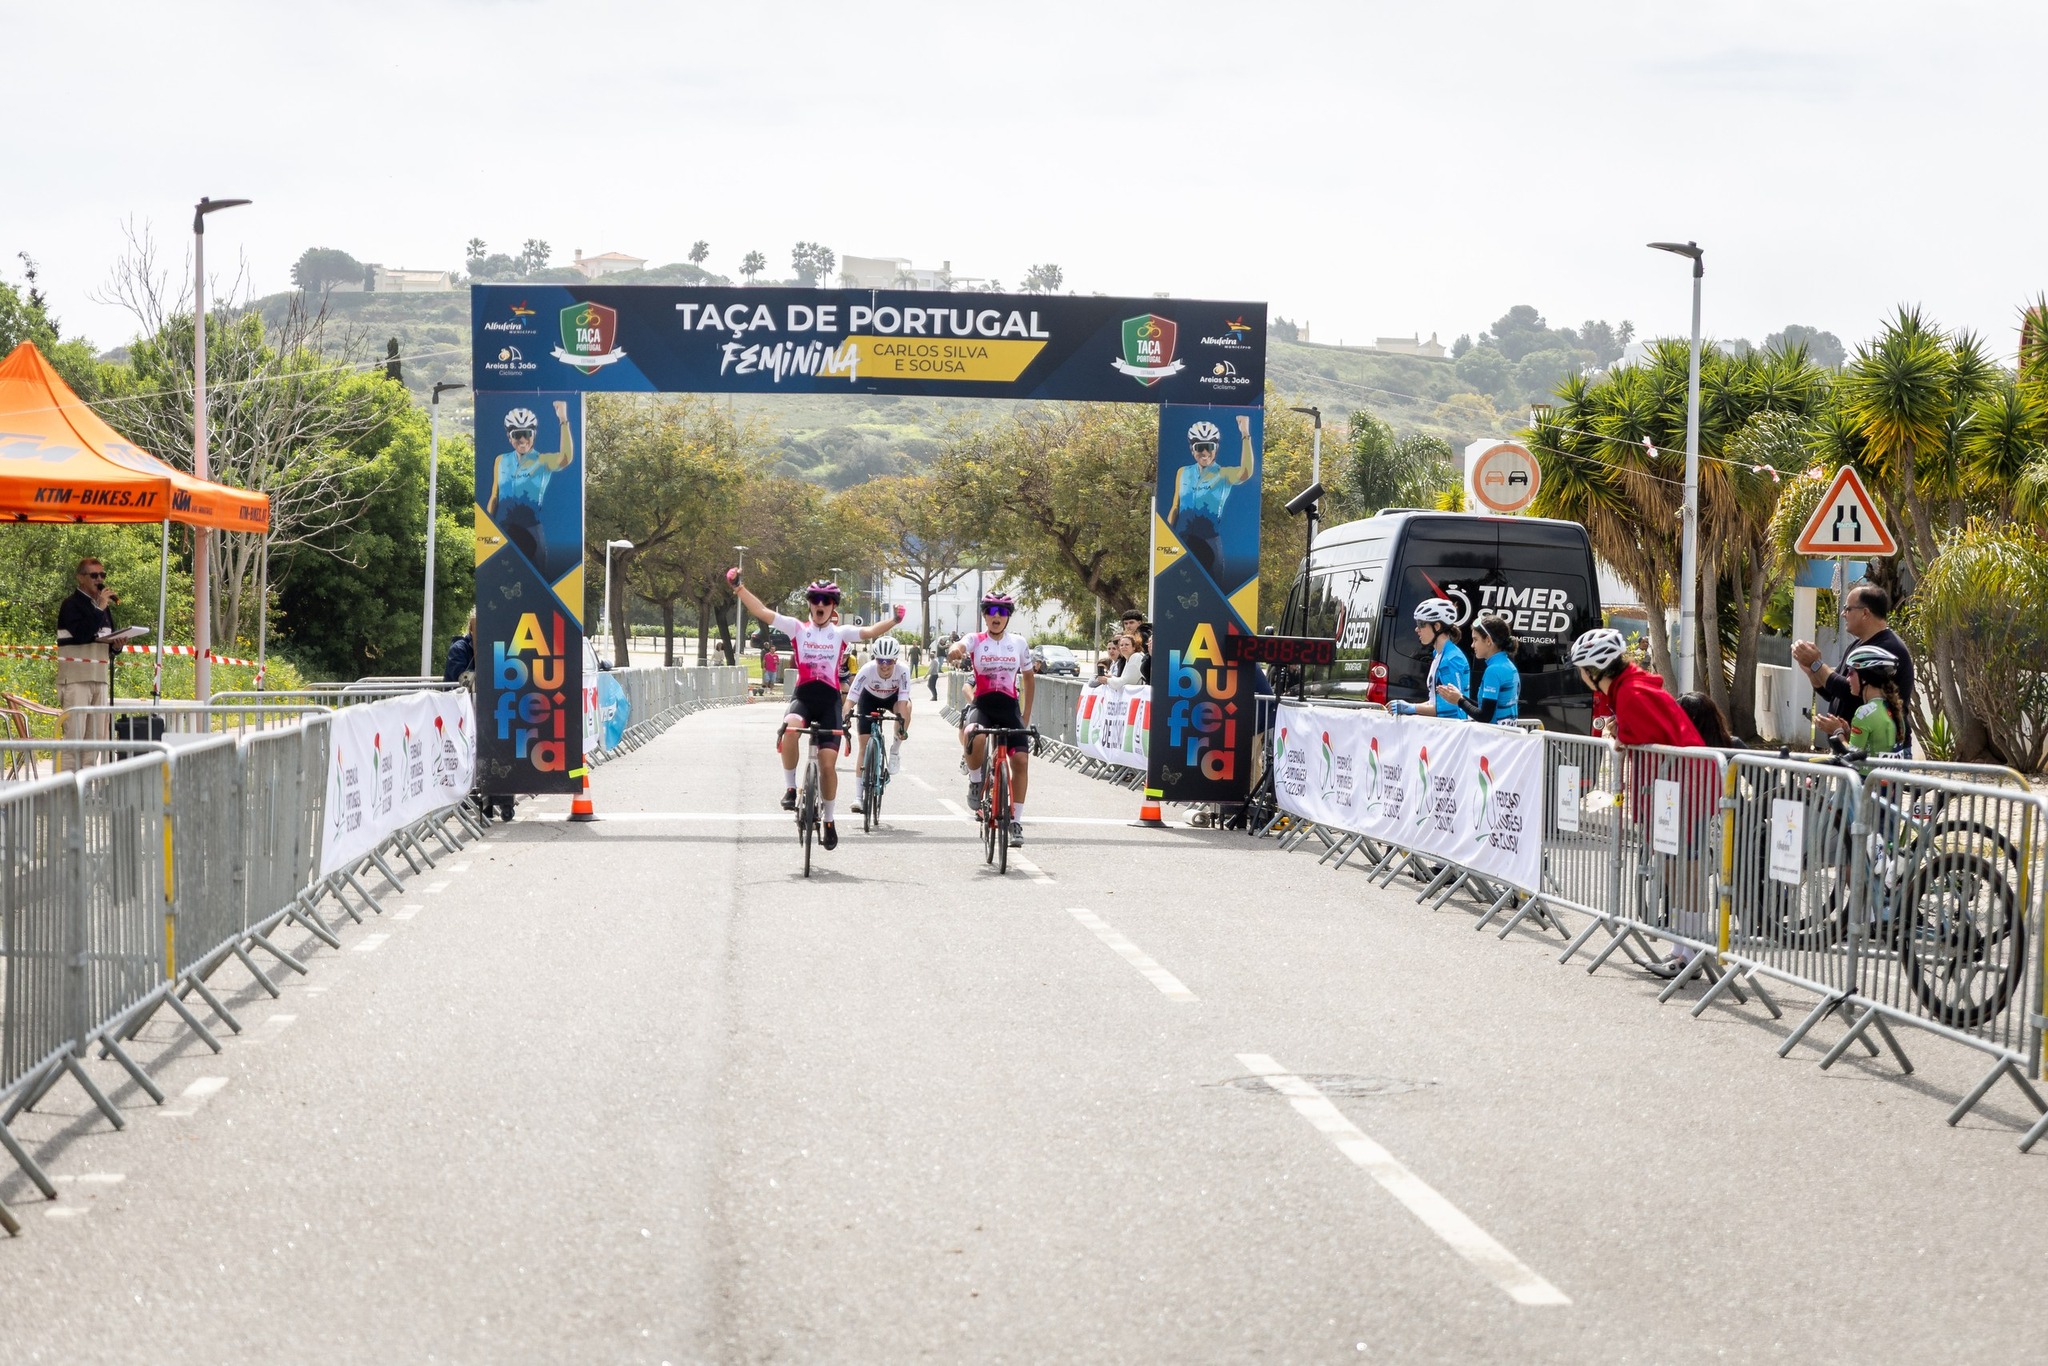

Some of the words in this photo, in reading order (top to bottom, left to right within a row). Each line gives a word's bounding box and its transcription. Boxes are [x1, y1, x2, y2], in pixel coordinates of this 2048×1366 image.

[484, 322, 522, 332] Albufeira
[675, 303, 777, 339] TAÇA
[786, 304, 838, 332] DE
[849, 304, 1050, 338] PORTUGAL
[575, 328, 601, 344] TAÇA
[1200, 336, 1237, 346] Albufeira
[575, 343, 602, 352] PORTUGAL
[873, 343, 940, 359] CARLOS
[943, 345, 988, 360] SILVA
[1136, 339, 1161, 355] TAÇA
[485, 362, 508, 370] Areias
[509, 362, 517, 370] S.
[518, 361, 537, 370] João
[895, 358, 905, 372] E
[909, 359, 966, 373] SOUSA
[1136, 355, 1162, 364] PORTUGAL
[1200, 375, 1223, 384] Areias
[1223, 376, 1231, 384] S.
[1231, 376, 1250, 385] João
[34, 487, 158, 507] KTM-BIKES.AT
[172, 488, 191, 512] KTM
[1478, 585, 1568, 610] TIMER
[1343, 622, 1370, 649] SPEED
[1237, 638, 1331, 664] 12:08:20
[1913, 804, 1933, 815] 67
